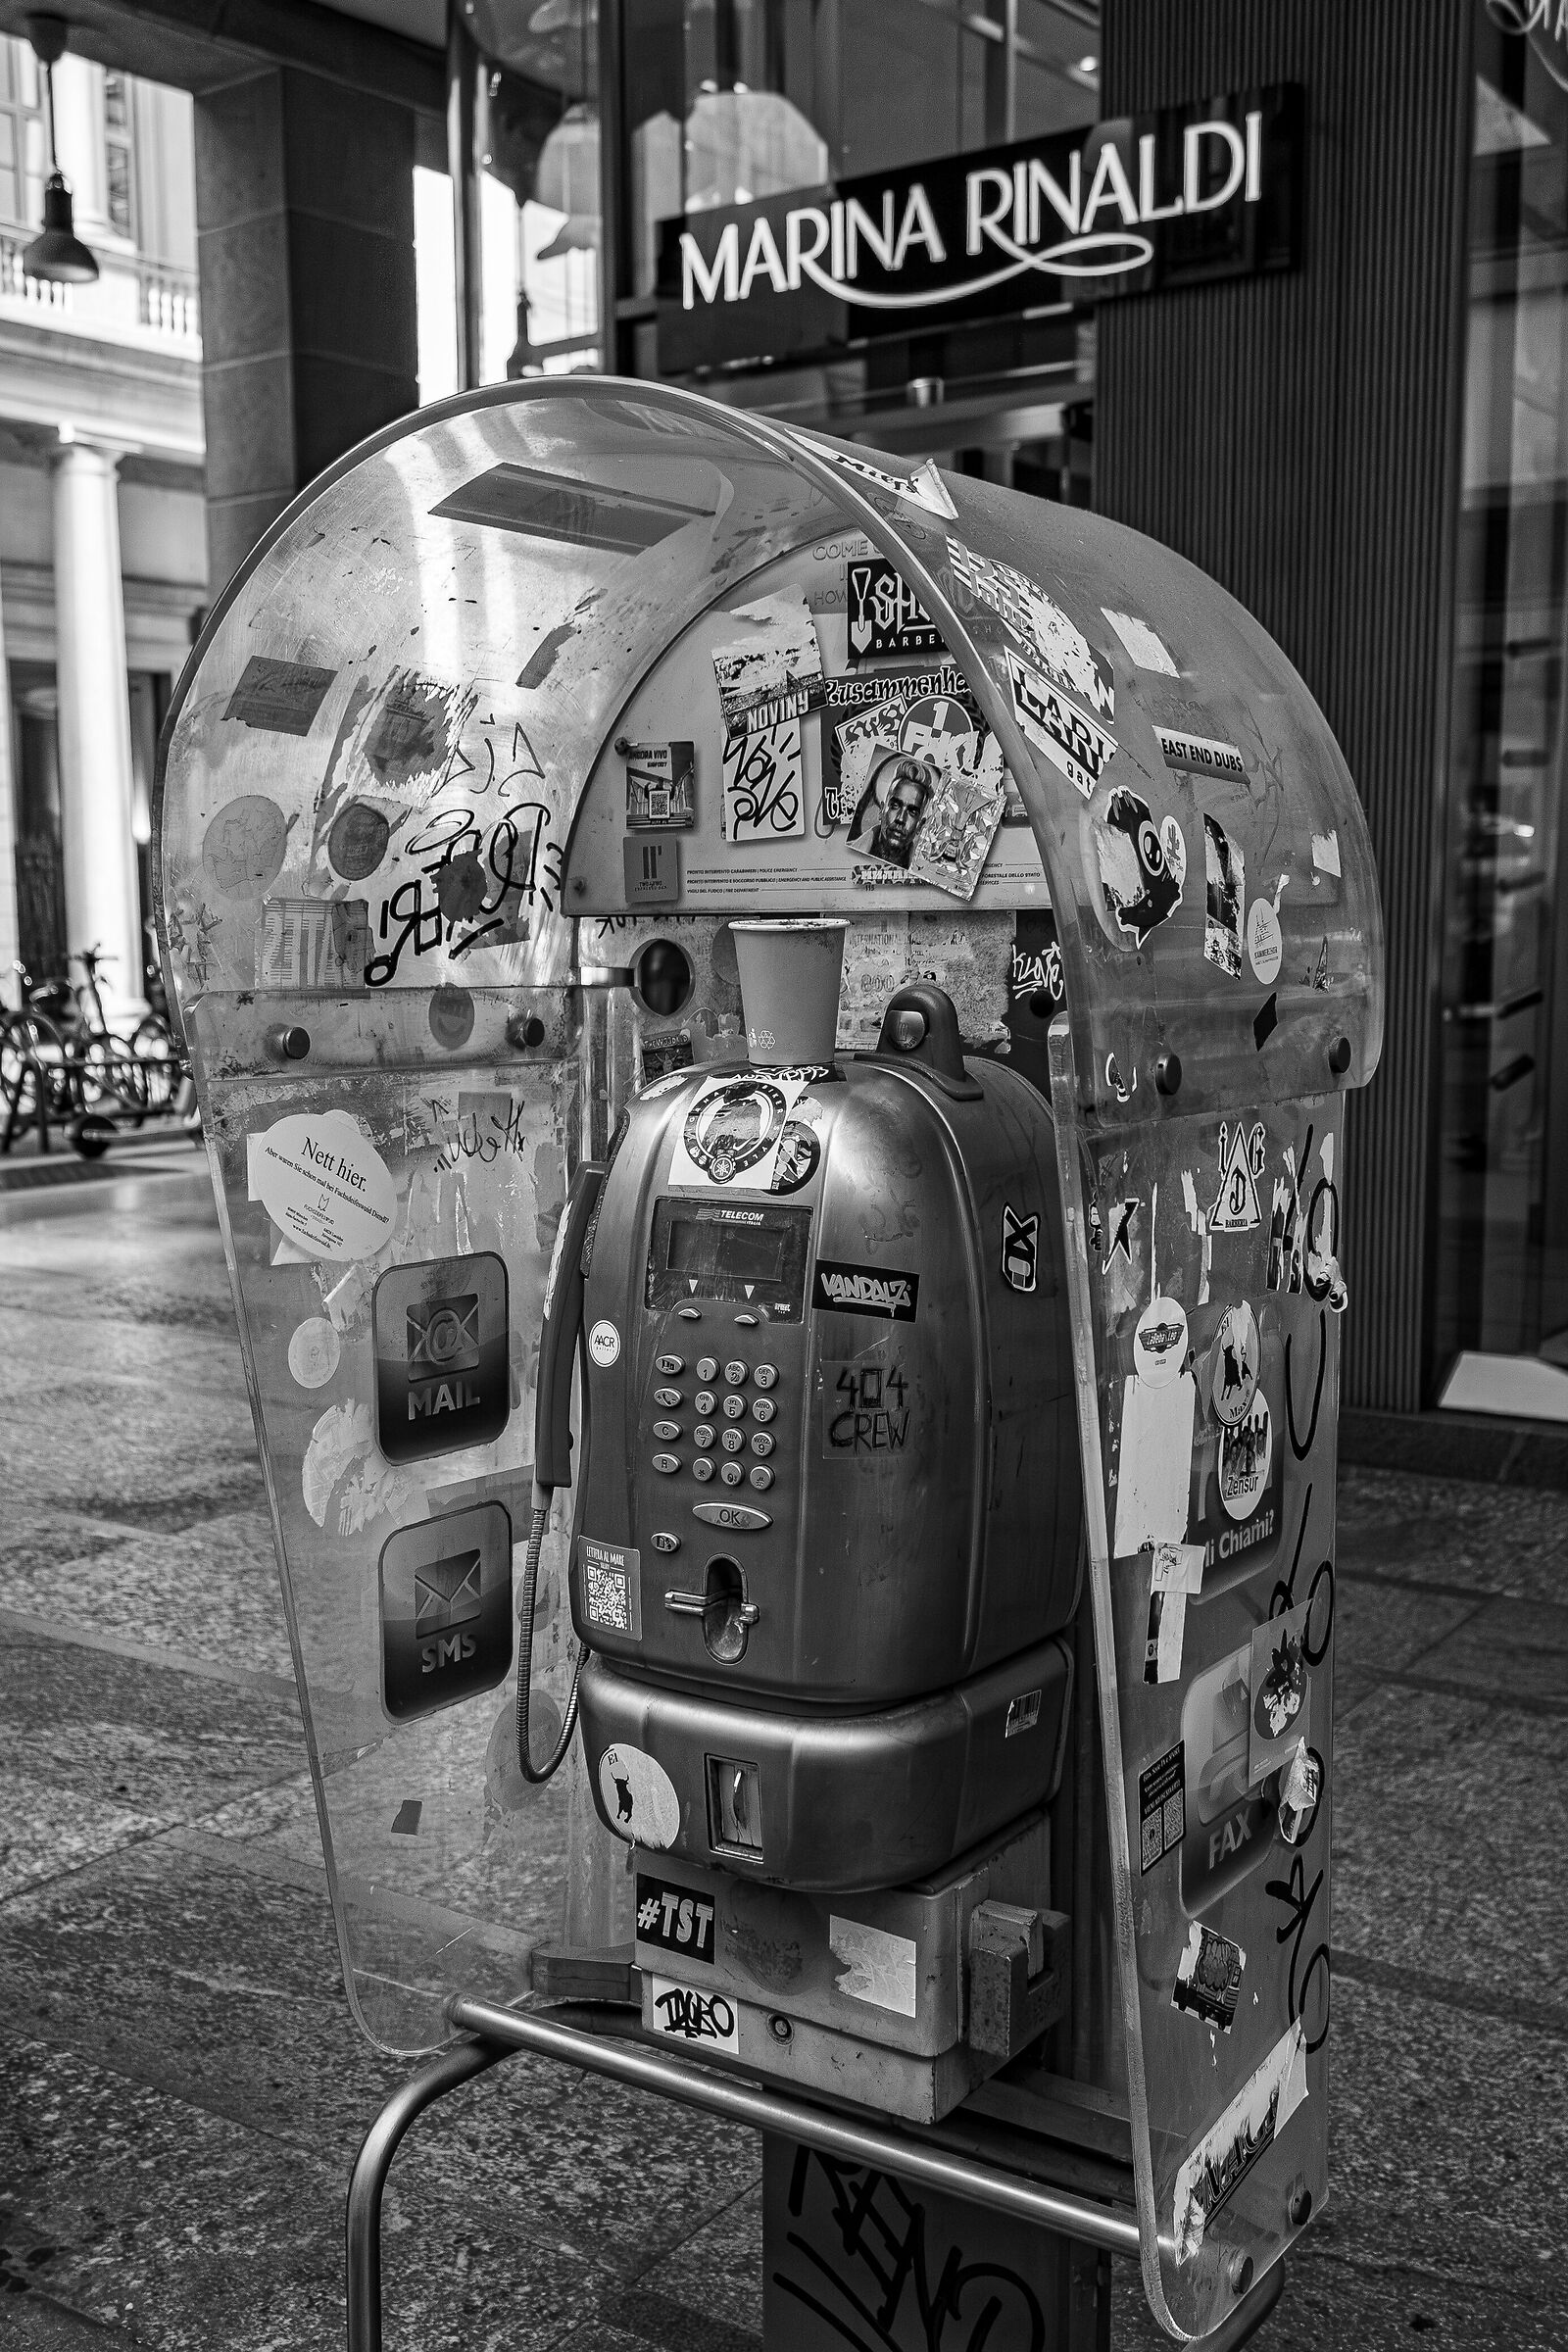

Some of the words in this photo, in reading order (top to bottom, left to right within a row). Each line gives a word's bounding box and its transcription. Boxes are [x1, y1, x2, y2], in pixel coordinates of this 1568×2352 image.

[680, 182, 947, 310] MARINA
[965, 110, 1263, 278] RINALDI
[812, 540, 868, 561] COME
[875, 633, 945, 649] BARBE
[746, 688, 809, 733] NOVINY
[1160, 737, 1188, 760] EAST
[1189, 744, 1213, 765] END
[1213, 750, 1244, 773] DUBS
[904, 1035, 918, 1049] PUSH
[265, 1146, 278, 1158] Aber
[278, 1154, 294, 1167] waren
[294, 1162, 303, 1174] Sie
[302, 1169, 317, 1182] schon
[316, 1177, 327, 1188] mal
[326, 1182, 335, 1193] bei
[301, 1136, 336, 1172] Nett
[336, 1157, 367, 1193] hier.
[720, 1209, 764, 1222] TELECOM
[594, 1334, 615, 1348] AACR
[703, 1369, 709, 1379] 1
[730, 1372, 740, 1382] 2
[760, 1375, 767, 1386] 3
[836, 1365, 909, 1410] 404
[408, 1381, 481, 1421] MAIL
[700, 1402, 707, 1412] 4
[728, 1406, 736, 1416] 5
[759, 1410, 766, 1421] 6
[662, 1426, 669, 1437] C
[829, 1408, 910, 1455] CREW
[700, 1437, 708, 1446] 7
[728, 1440, 735, 1450] 8
[758, 1444, 765, 1453] 9
[661, 1458, 668, 1469] R
[1226, 1474, 1259, 1497] Zensur
[719, 1509, 741, 1525] OK
[1218, 1508, 1275, 1559] Chiami?
[421, 1633, 477, 1673] SMS
[607, 1752, 619, 1766] El
[1208, 1811, 1252, 1870] FAX
[637, 1891, 714, 1948] #TST
